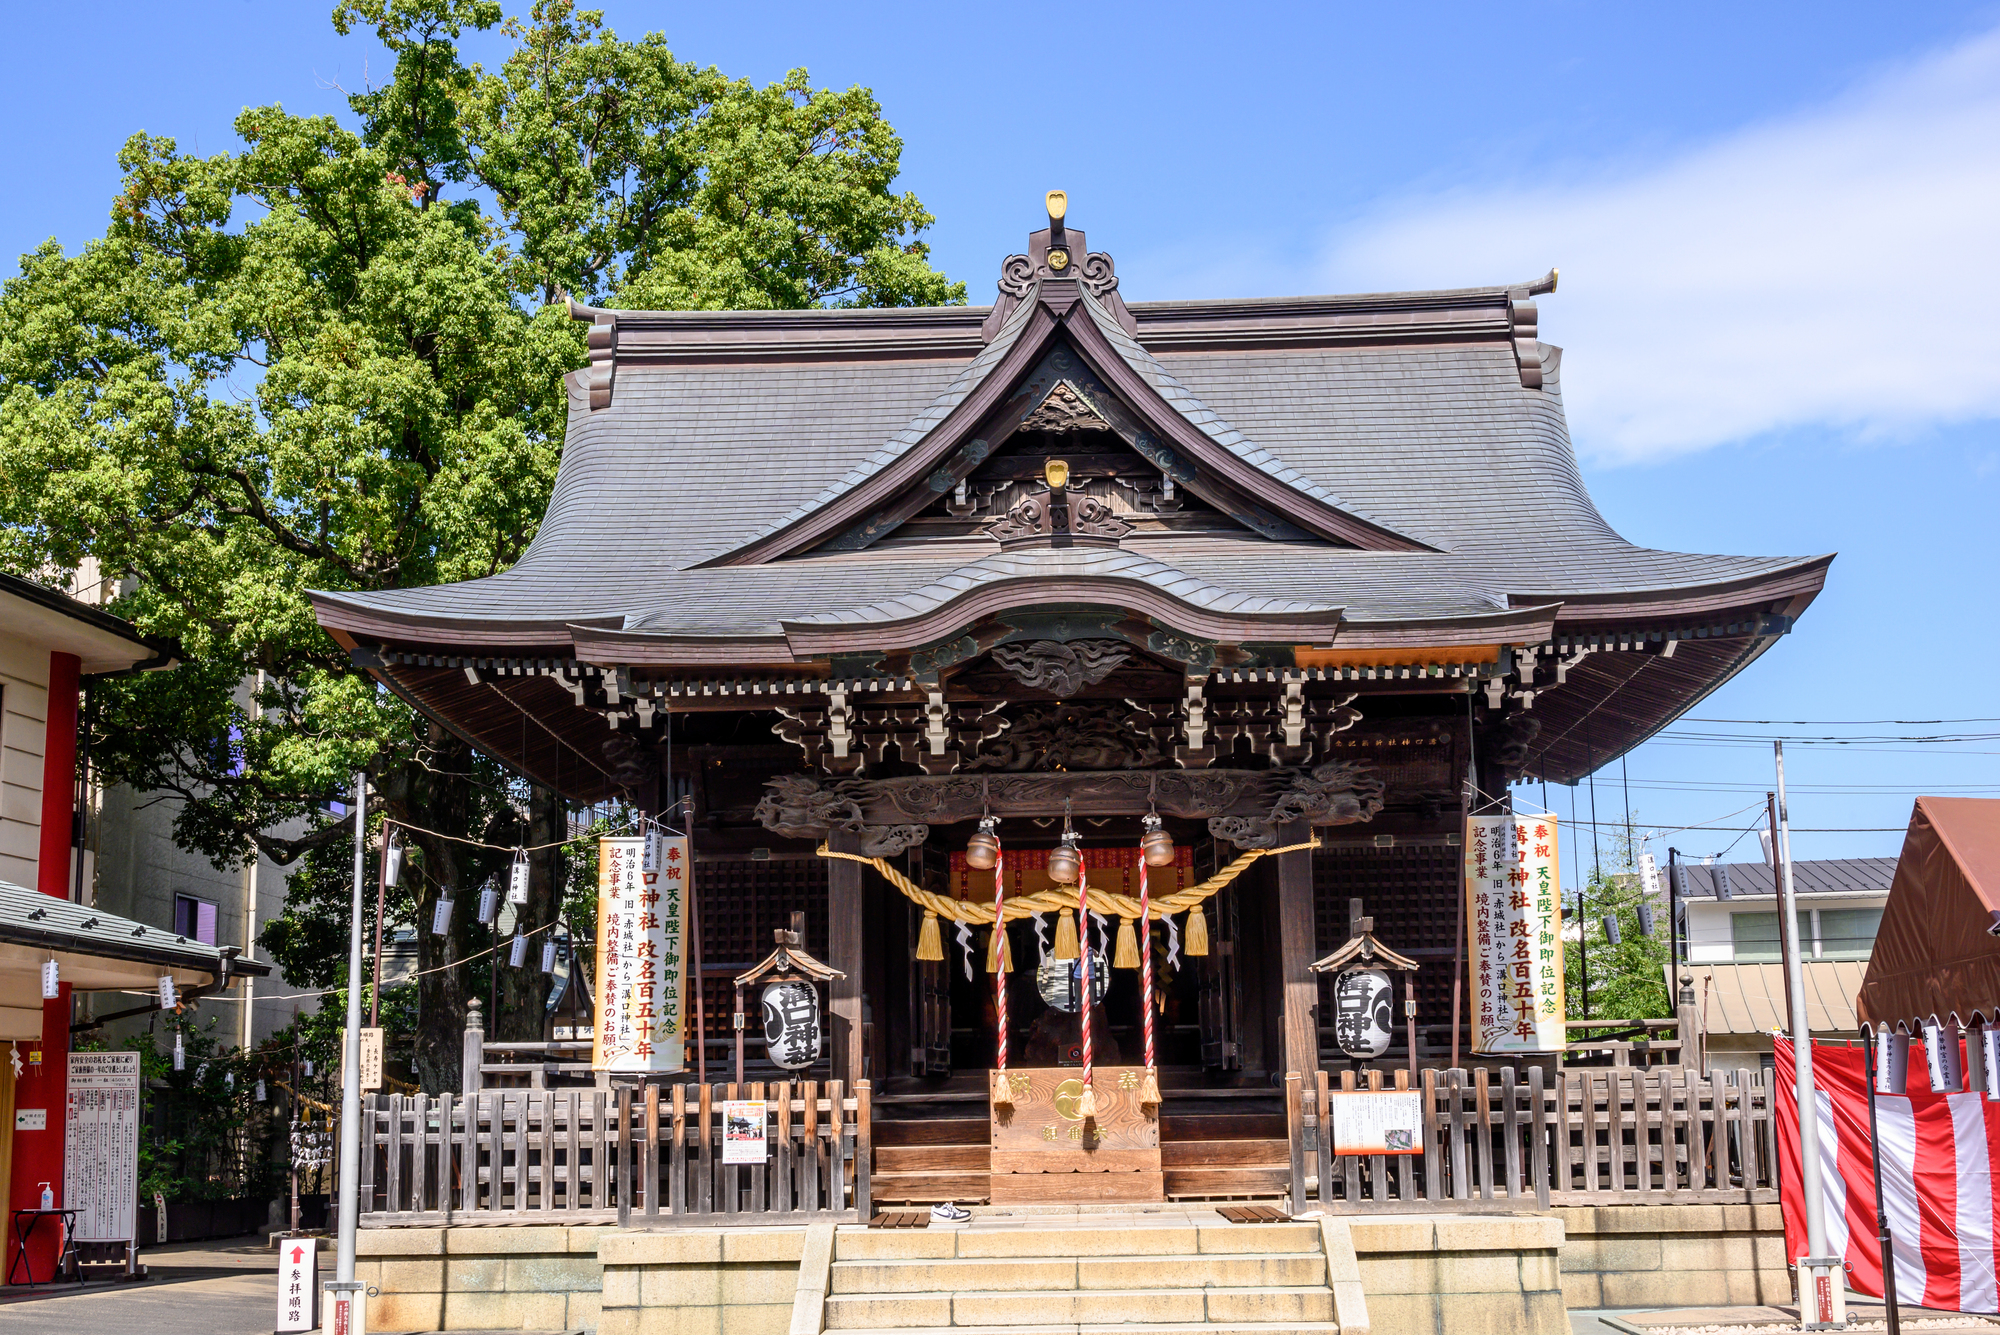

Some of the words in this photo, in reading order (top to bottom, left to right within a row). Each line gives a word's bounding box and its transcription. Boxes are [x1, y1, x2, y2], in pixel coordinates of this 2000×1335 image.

[608, 847, 622, 899] 記念事業
[624, 847, 636, 892] 明治6年
[665, 846, 682, 880] 奉祝
[1473, 826, 1489, 879] 記念事業
[1490, 826, 1503, 872] 明治6年
[1533, 824, 1551, 858] 奉祝
[619, 899, 634, 1051] 旧「赤城社」から「溝口神社」へ
[661, 887, 681, 1035] 天皇陛下御即位記念
[1475, 892, 1495, 1040] 境内整備ご奉賛のお願い
[1492, 879, 1509, 1032] 旧「赤城社」から「溝口神社」へ
[1509, 918, 1536, 1042] 改名百五十年
[1536, 866, 1557, 1015] 天皇陛下御即位記念
[602, 913, 620, 1059] 境内整備ご奉賛のお願い
[633, 941, 660, 1062] 改名百五十年
[778, 982, 819, 1066] 溝口神社
[1337, 971, 1374, 1055] 溝口神社
[288, 1268, 302, 1323] 参拝順路
